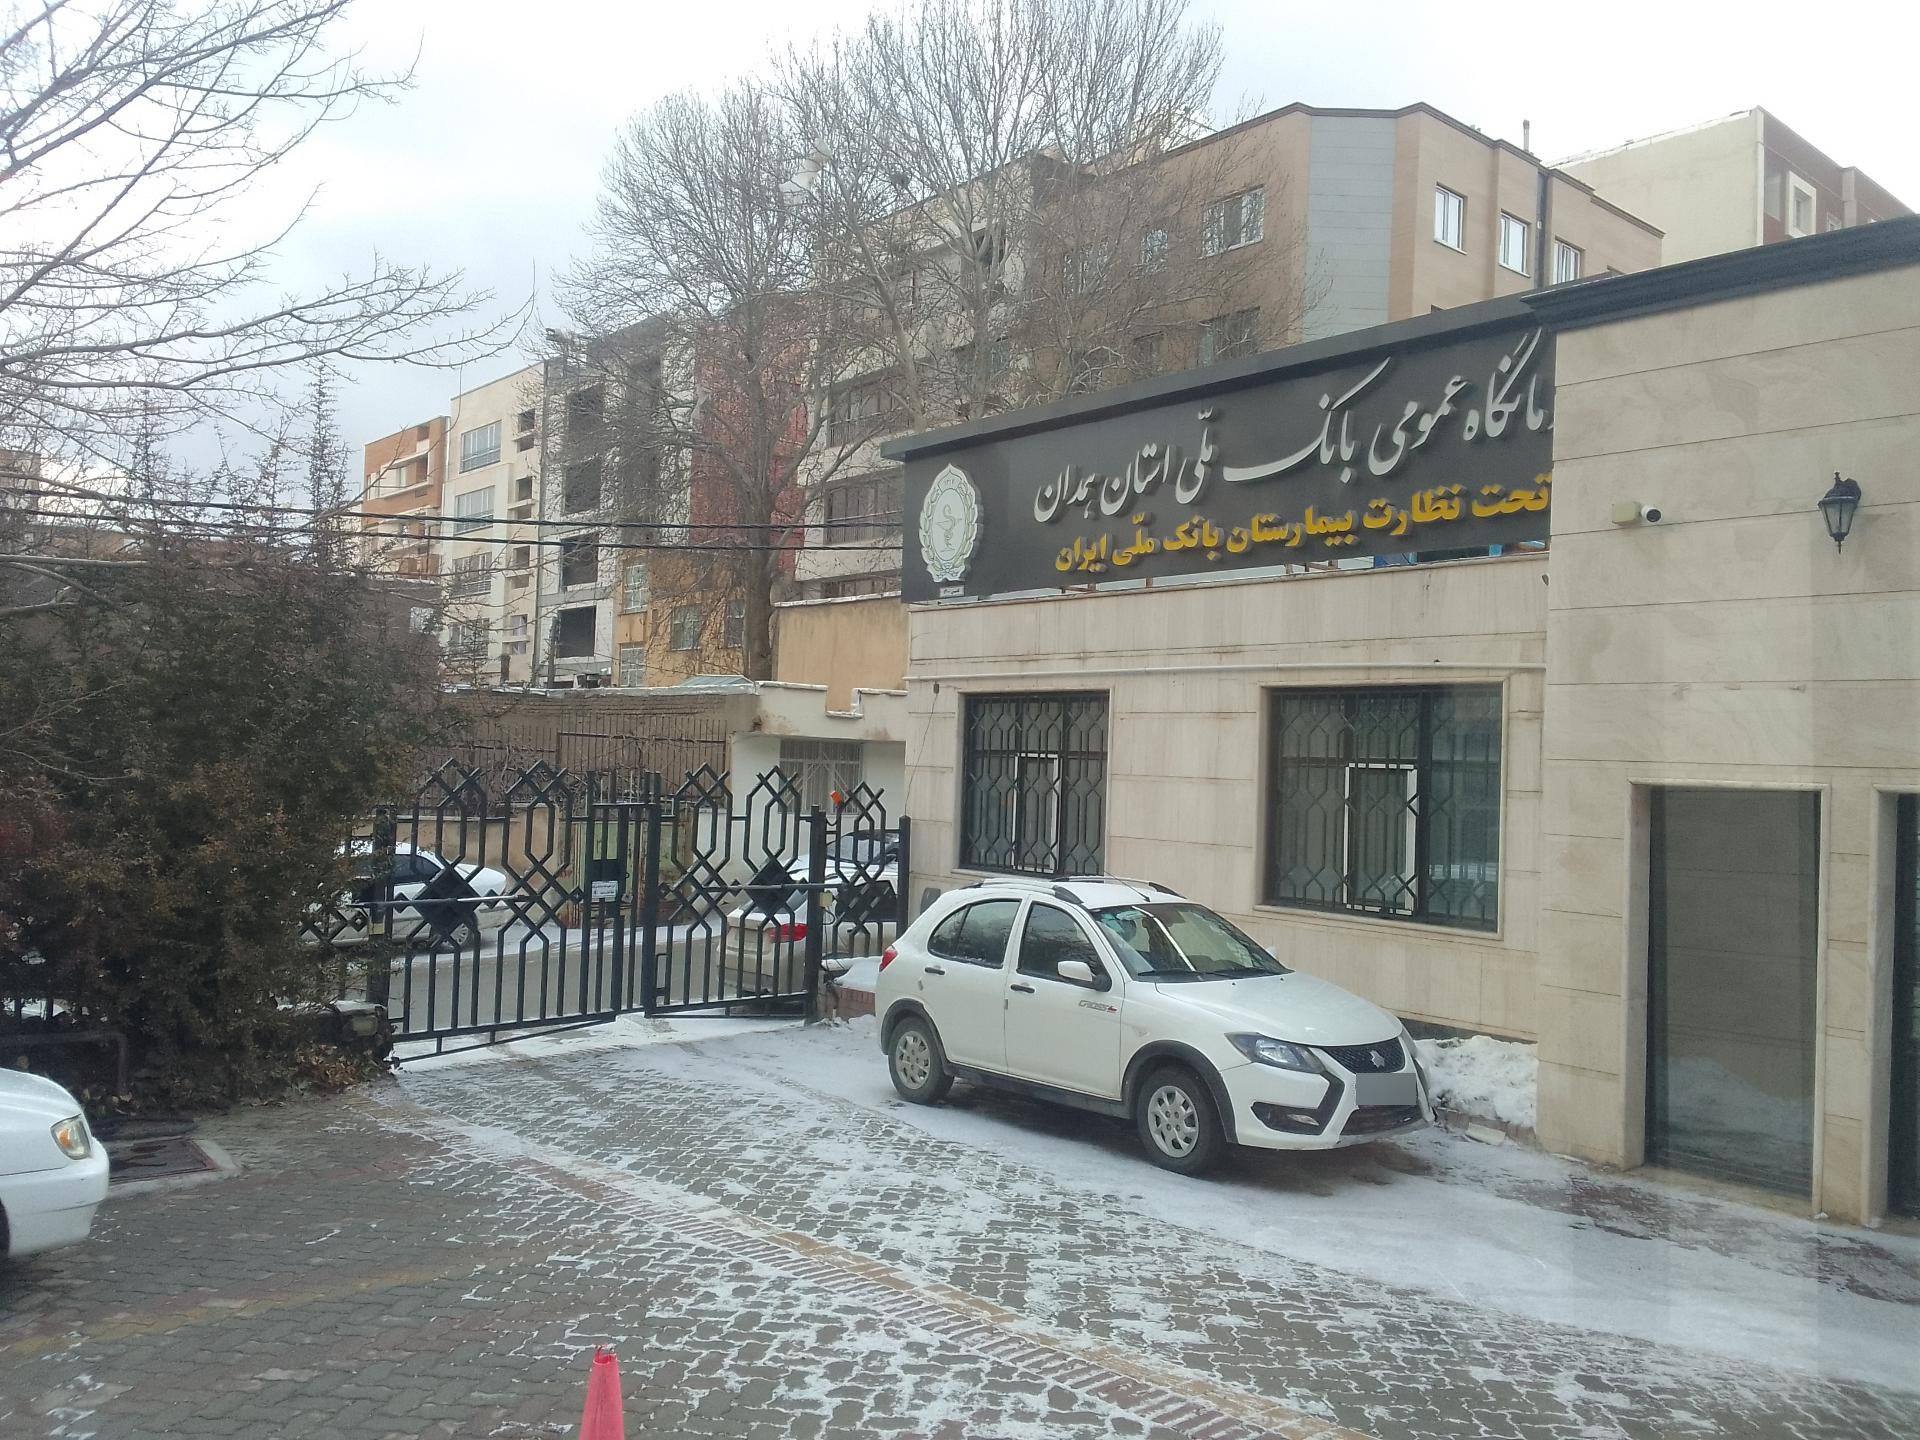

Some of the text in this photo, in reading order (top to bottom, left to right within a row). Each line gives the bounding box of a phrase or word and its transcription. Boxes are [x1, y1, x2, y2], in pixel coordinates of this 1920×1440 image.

[1462, 327, 1554, 441] مانگاه
[1223, 356, 1391, 484] بانک
[1368, 375, 1469, 476] عمومی
[1034, 464, 1097, 523] همدان
[1100, 443, 1170, 516] استان
[1471, 472, 1552, 518] تحت
[1226, 505, 1355, 554] بیمارستان
[1362, 484, 1463, 536] نظارت
[1055, 533, 1108, 573] ایران
[1162, 514, 1220, 562] بانک
